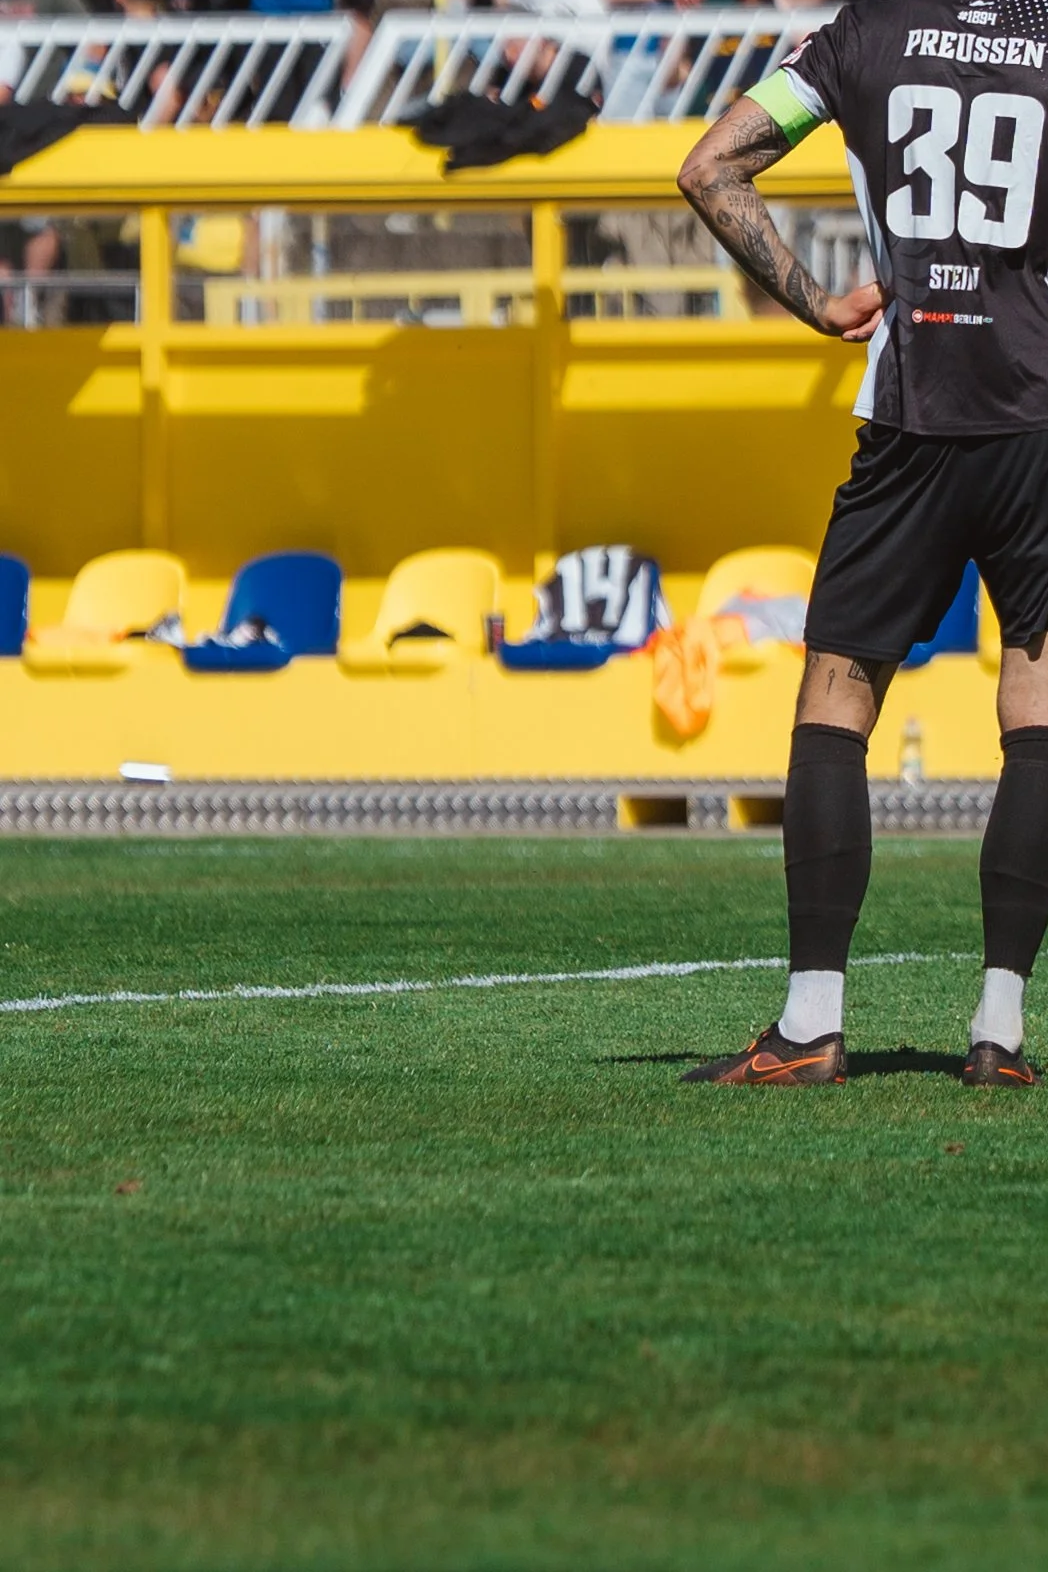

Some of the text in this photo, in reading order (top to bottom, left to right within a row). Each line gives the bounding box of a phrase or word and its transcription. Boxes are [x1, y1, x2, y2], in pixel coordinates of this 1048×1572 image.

[957, 10, 998, 26] #1894
[903, 29, 1047, 69] PREUSSEN
[886, 84, 1045, 249] 39
[929, 263, 980, 292] STEIN
[556, 544, 632, 632] 14
